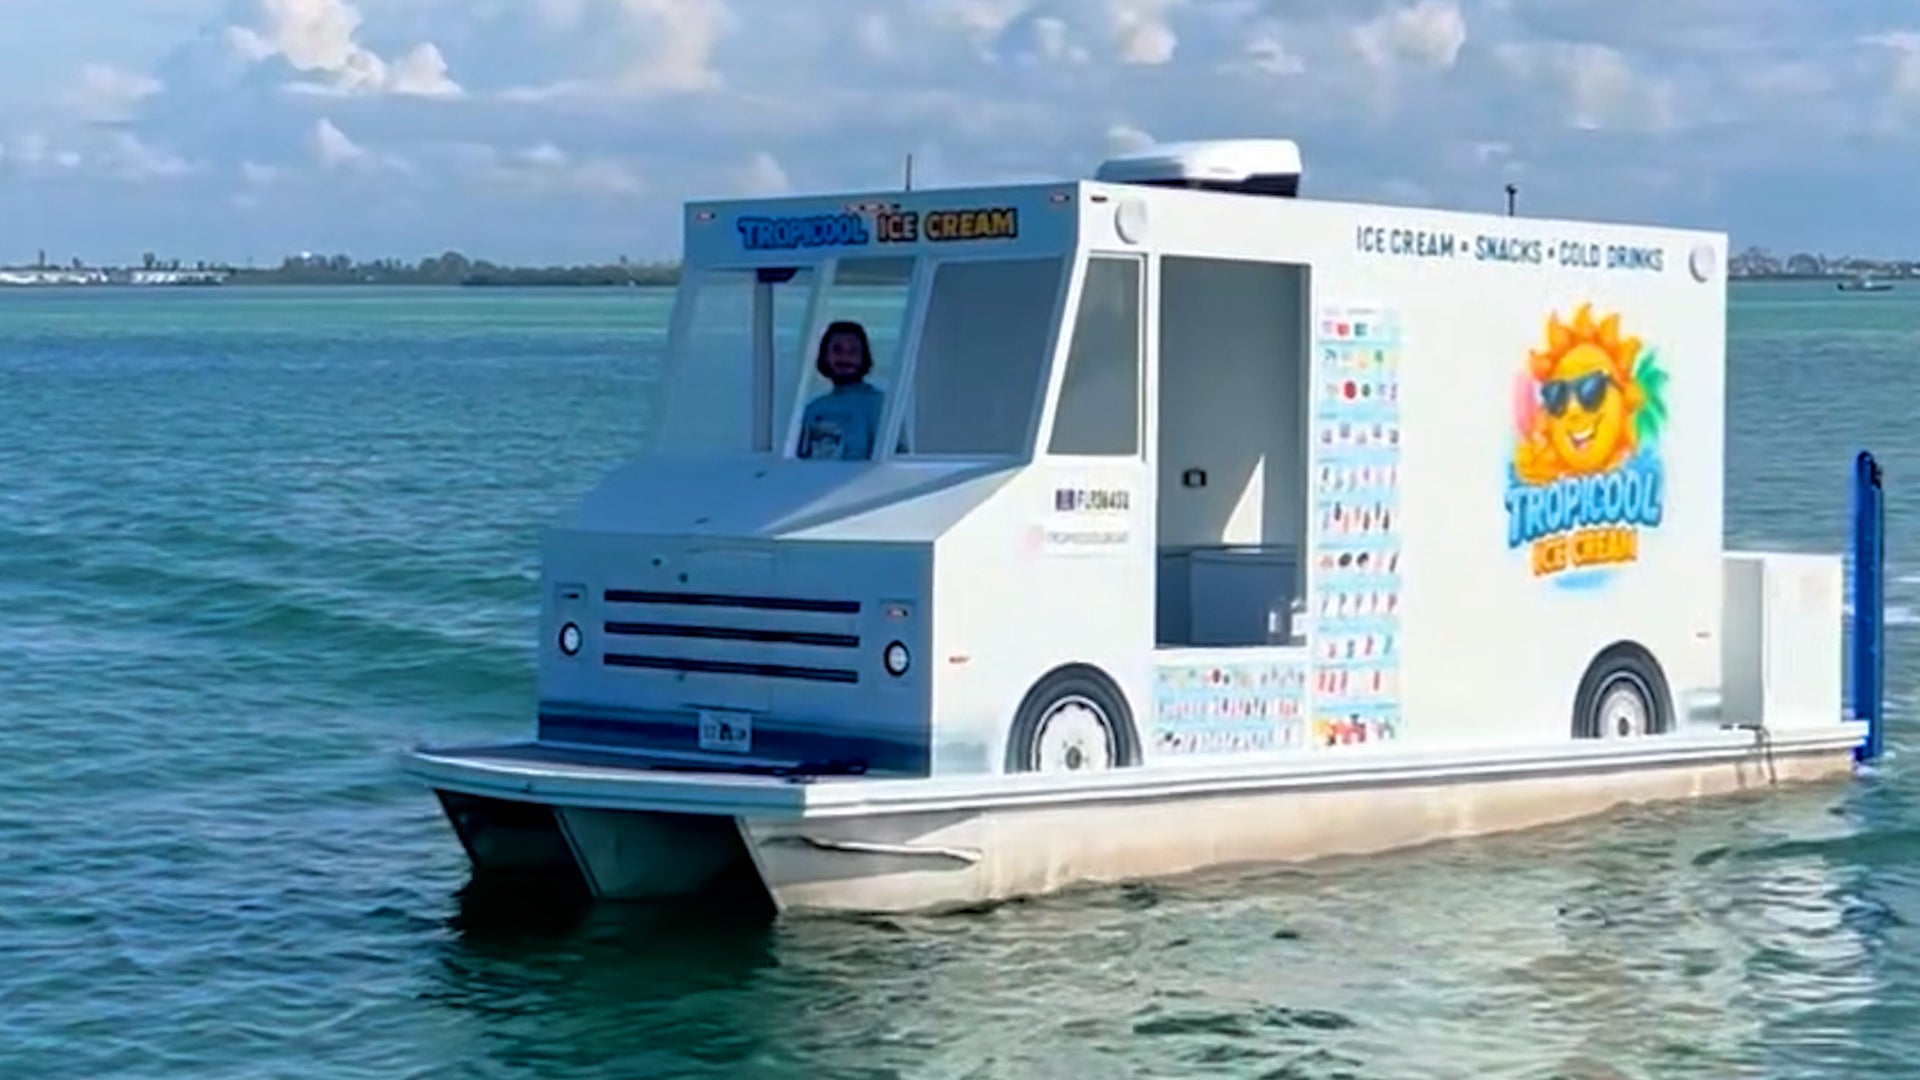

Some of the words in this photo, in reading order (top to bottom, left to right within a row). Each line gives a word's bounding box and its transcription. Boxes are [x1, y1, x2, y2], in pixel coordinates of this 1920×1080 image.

[738, 214, 868, 248] TROPICOOL
[877, 212, 918, 242] ICE
[924, 208, 1018, 240] CREAM
[1356, 226, 1385, 253] ICE
[1390, 226, 1454, 257] CREAM
[1474, 235, 1542, 264] SNACKS
[1559, 240, 1600, 267] COLD
[1607, 244, 1664, 271] DRINKS
[1505, 469, 1662, 549] TROPICOOL
[1533, 536, 1567, 577] ICE
[1571, 526, 1638, 568] CREAM
